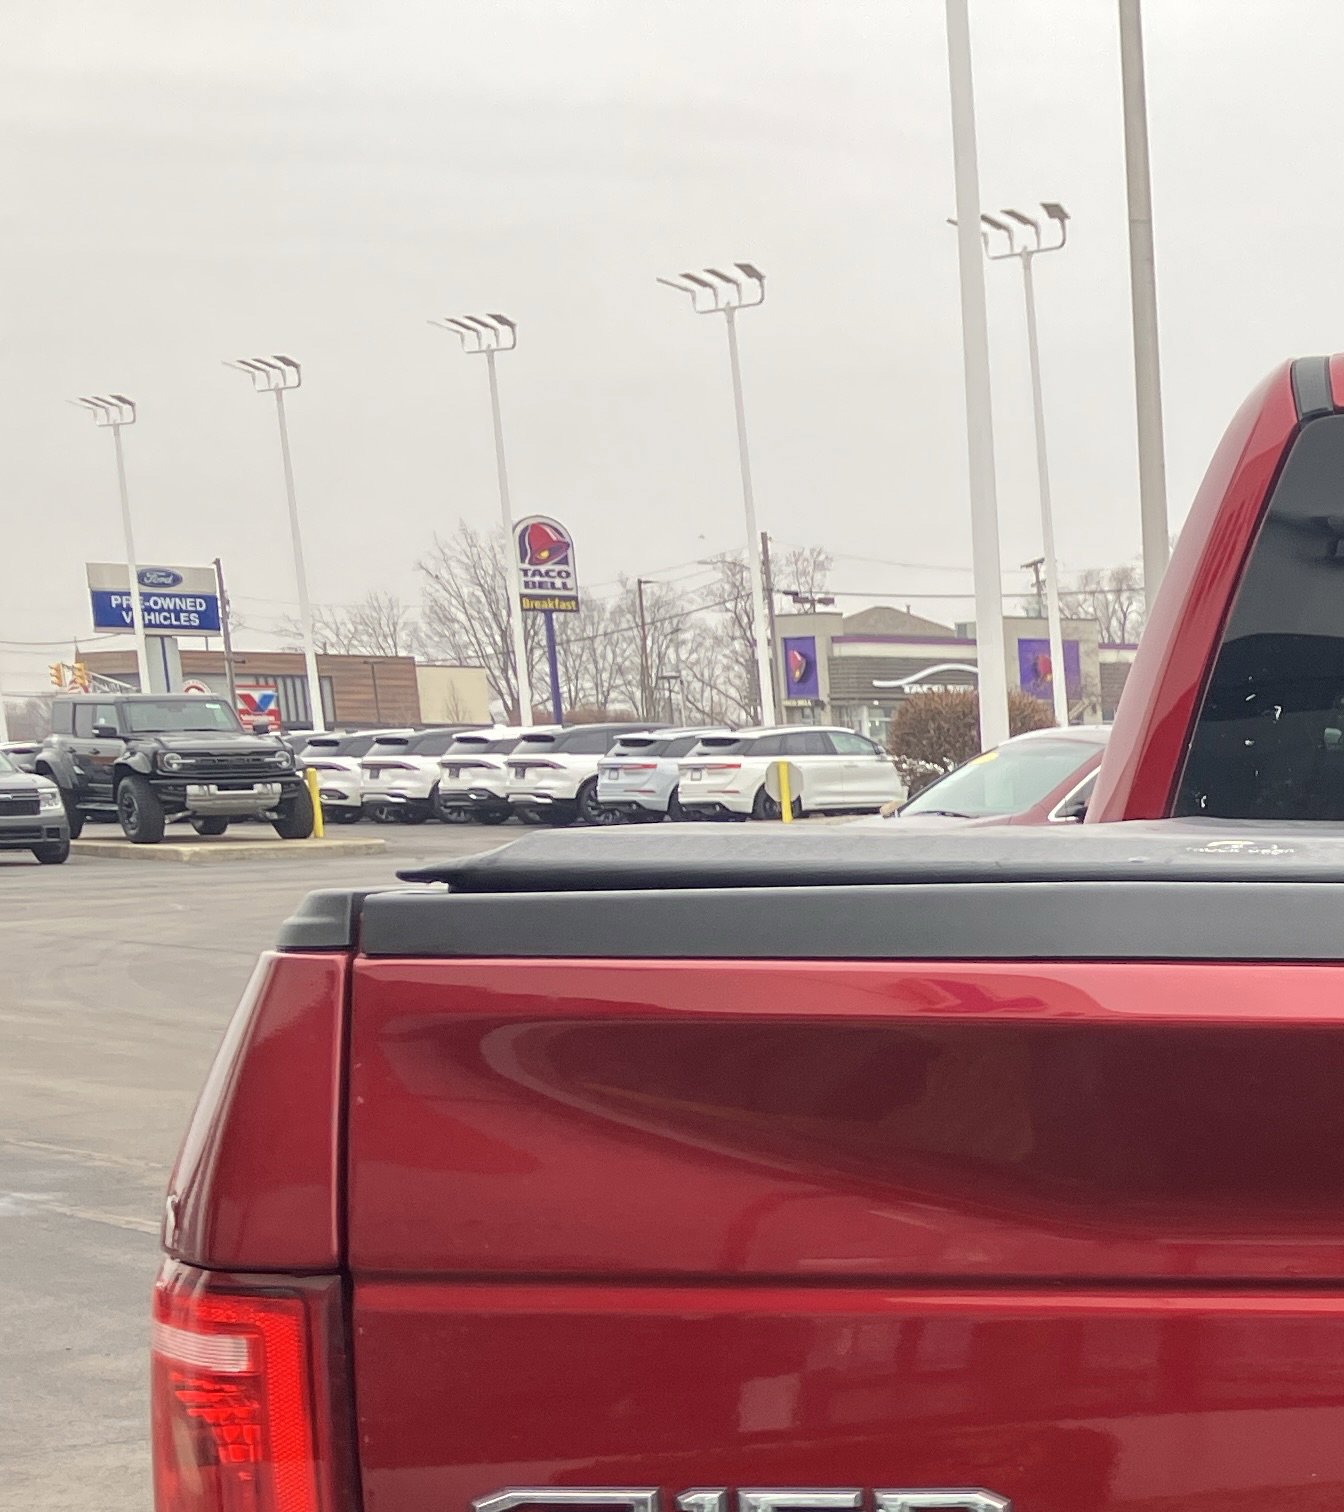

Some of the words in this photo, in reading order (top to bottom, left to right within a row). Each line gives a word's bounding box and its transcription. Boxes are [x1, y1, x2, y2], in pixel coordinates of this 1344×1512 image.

[519, 568, 571, 579] TACO
[524, 580, 573, 590] BELL
[522, 597, 576, 609] Breakfast
[121, 610, 200, 627] VHICLES
